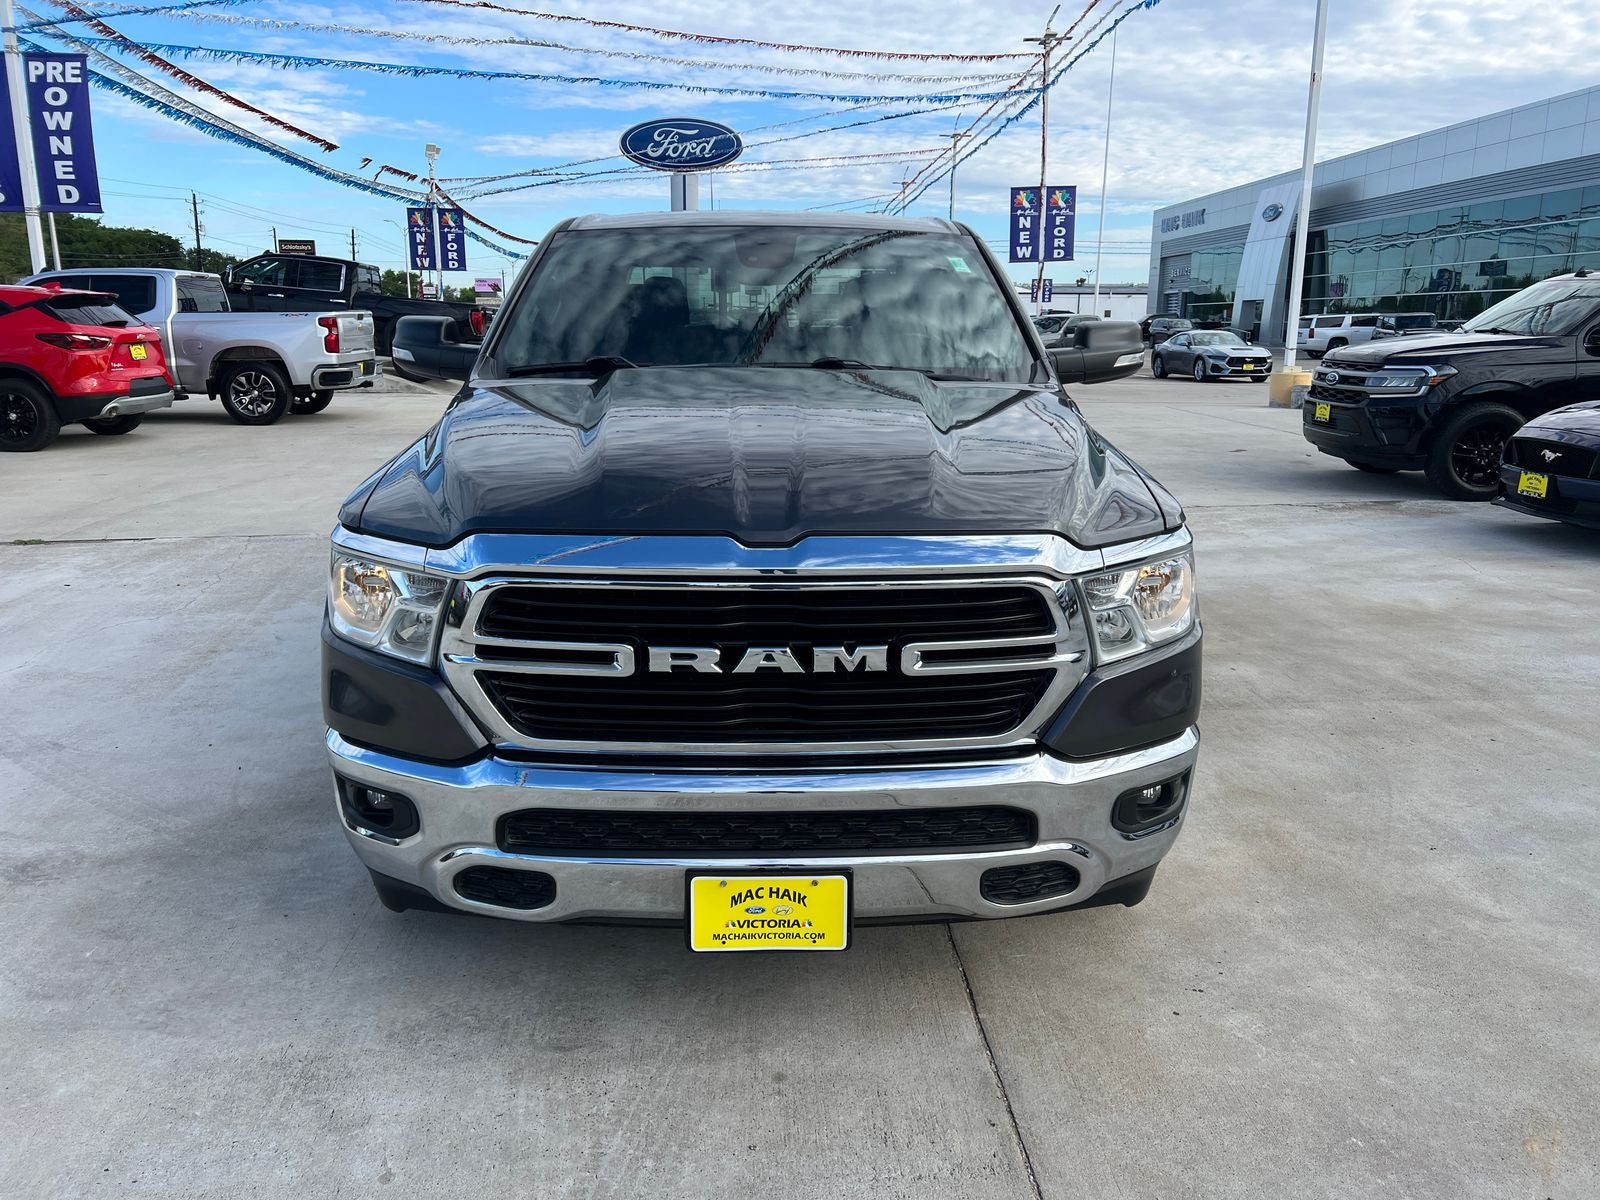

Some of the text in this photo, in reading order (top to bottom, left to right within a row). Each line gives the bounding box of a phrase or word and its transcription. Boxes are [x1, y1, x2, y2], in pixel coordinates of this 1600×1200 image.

[28, 61, 82, 83] PRE
[42, 86, 80, 204] OWNED
[647, 127, 716, 158] Ford
[446, 233, 459, 269] FORD
[1016, 216, 1032, 258] NEW
[1053, 216, 1067, 258] FORD
[648, 646, 888, 673] RAM
[730, 886, 808, 908] MAC HAIK
[712, 932, 825, 941] MACHAIKVICTORIA.COM
[736, 919, 801, 929] VICTORIA
